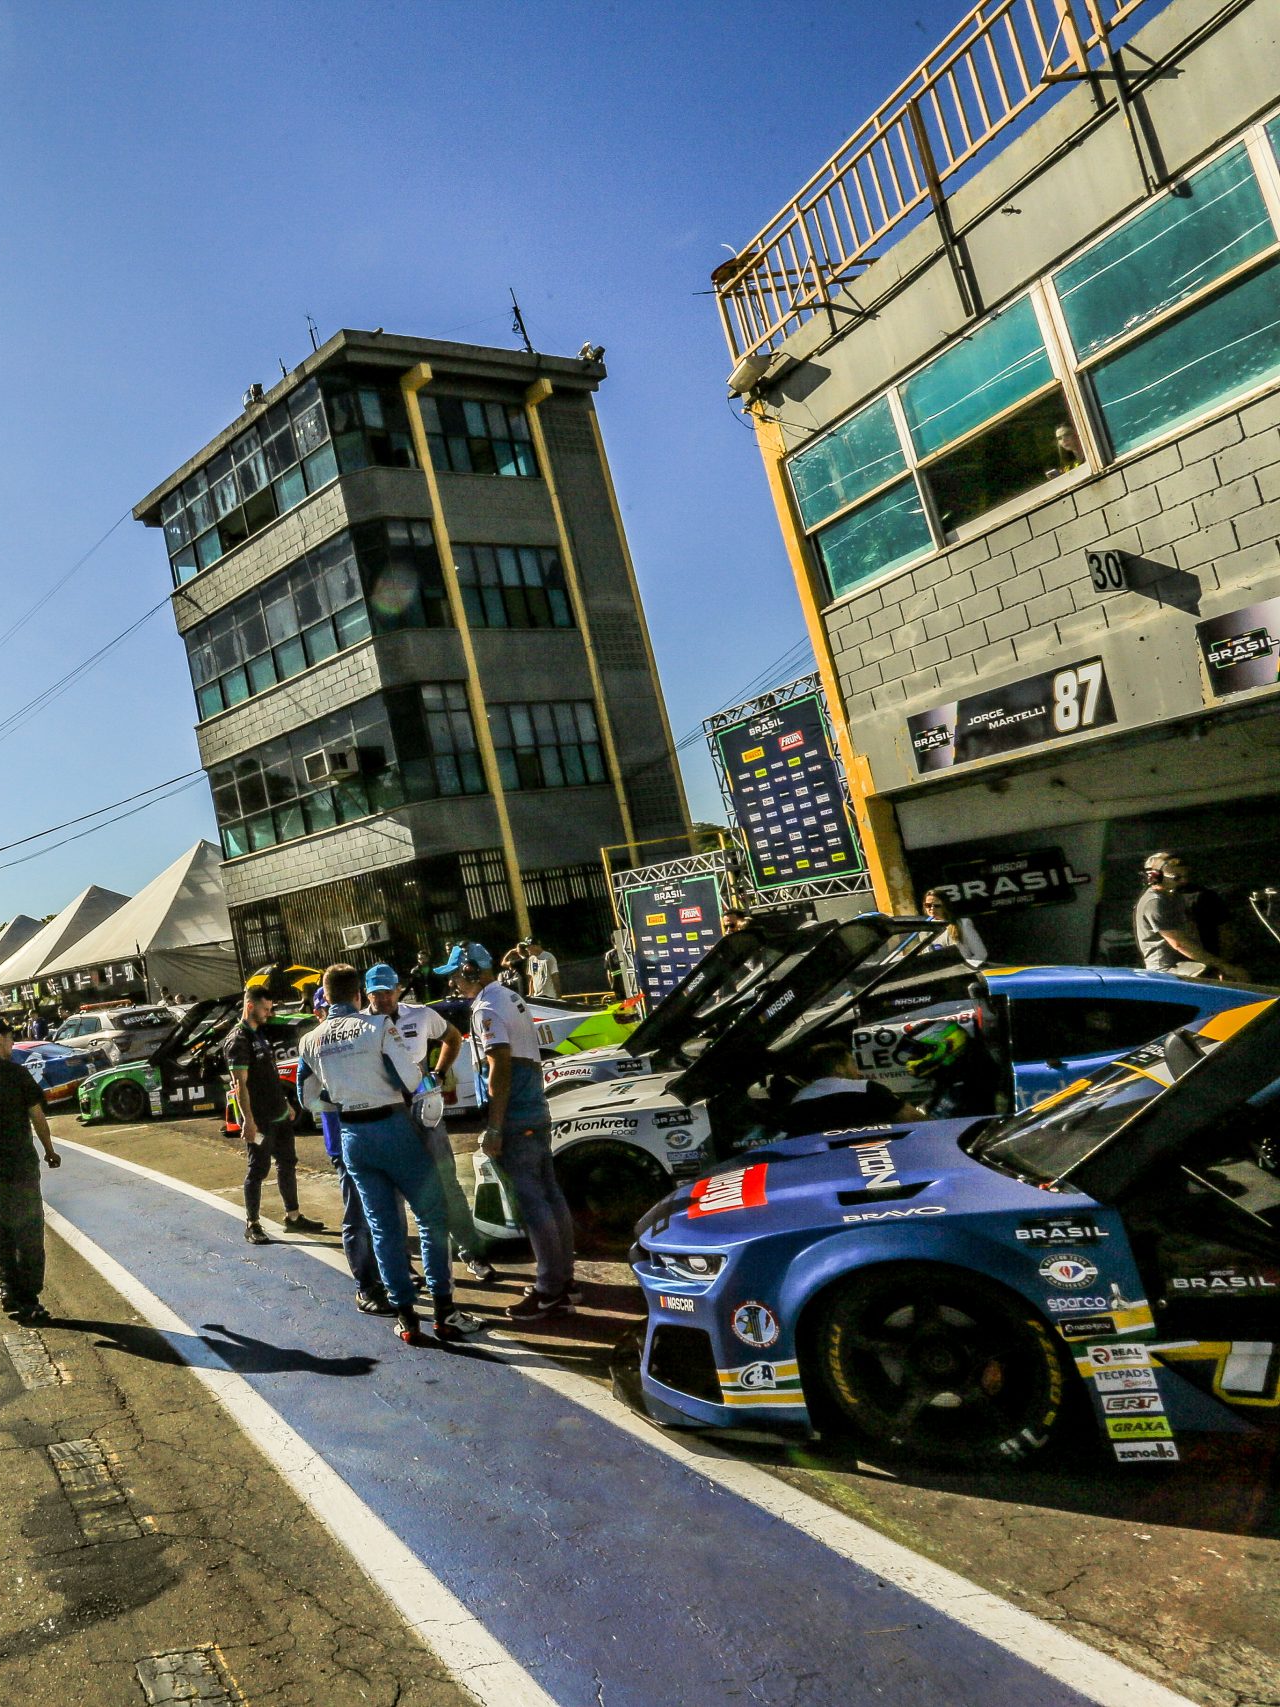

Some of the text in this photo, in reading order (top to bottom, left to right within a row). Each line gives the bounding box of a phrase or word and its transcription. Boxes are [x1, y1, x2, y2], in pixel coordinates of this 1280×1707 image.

[1089, 553, 1123, 590] 30
[1208, 636, 1279, 663] BRASIL
[1053, 660, 1103, 733] 87
[967, 708, 1005, 726] JORGE
[988, 705, 1046, 730] MARTELLI
[748, 717, 785, 737] BRASIL
[780, 732, 802, 748] FRUM
[913, 731, 954, 748] BRASIL
[654, 889, 686, 901] BRASIL
[766, 989, 796, 1018] NASCAR
[324, 1029, 360, 1045] NASCAR
[574, 1118, 638, 1132] konkreta
[842, 1205, 947, 1224] BRAVO
[1015, 1226, 1110, 1240] BRASIL
[1172, 1276, 1276, 1289] BRASIL
[667, 1296, 695, 1312] NASCAR
[1047, 1297, 1107, 1312] sparco
[1112, 1348, 1141, 1357] REAL
[1096, 1368, 1151, 1381] TECPADS
[1112, 1421, 1166, 1433] GRAXA
